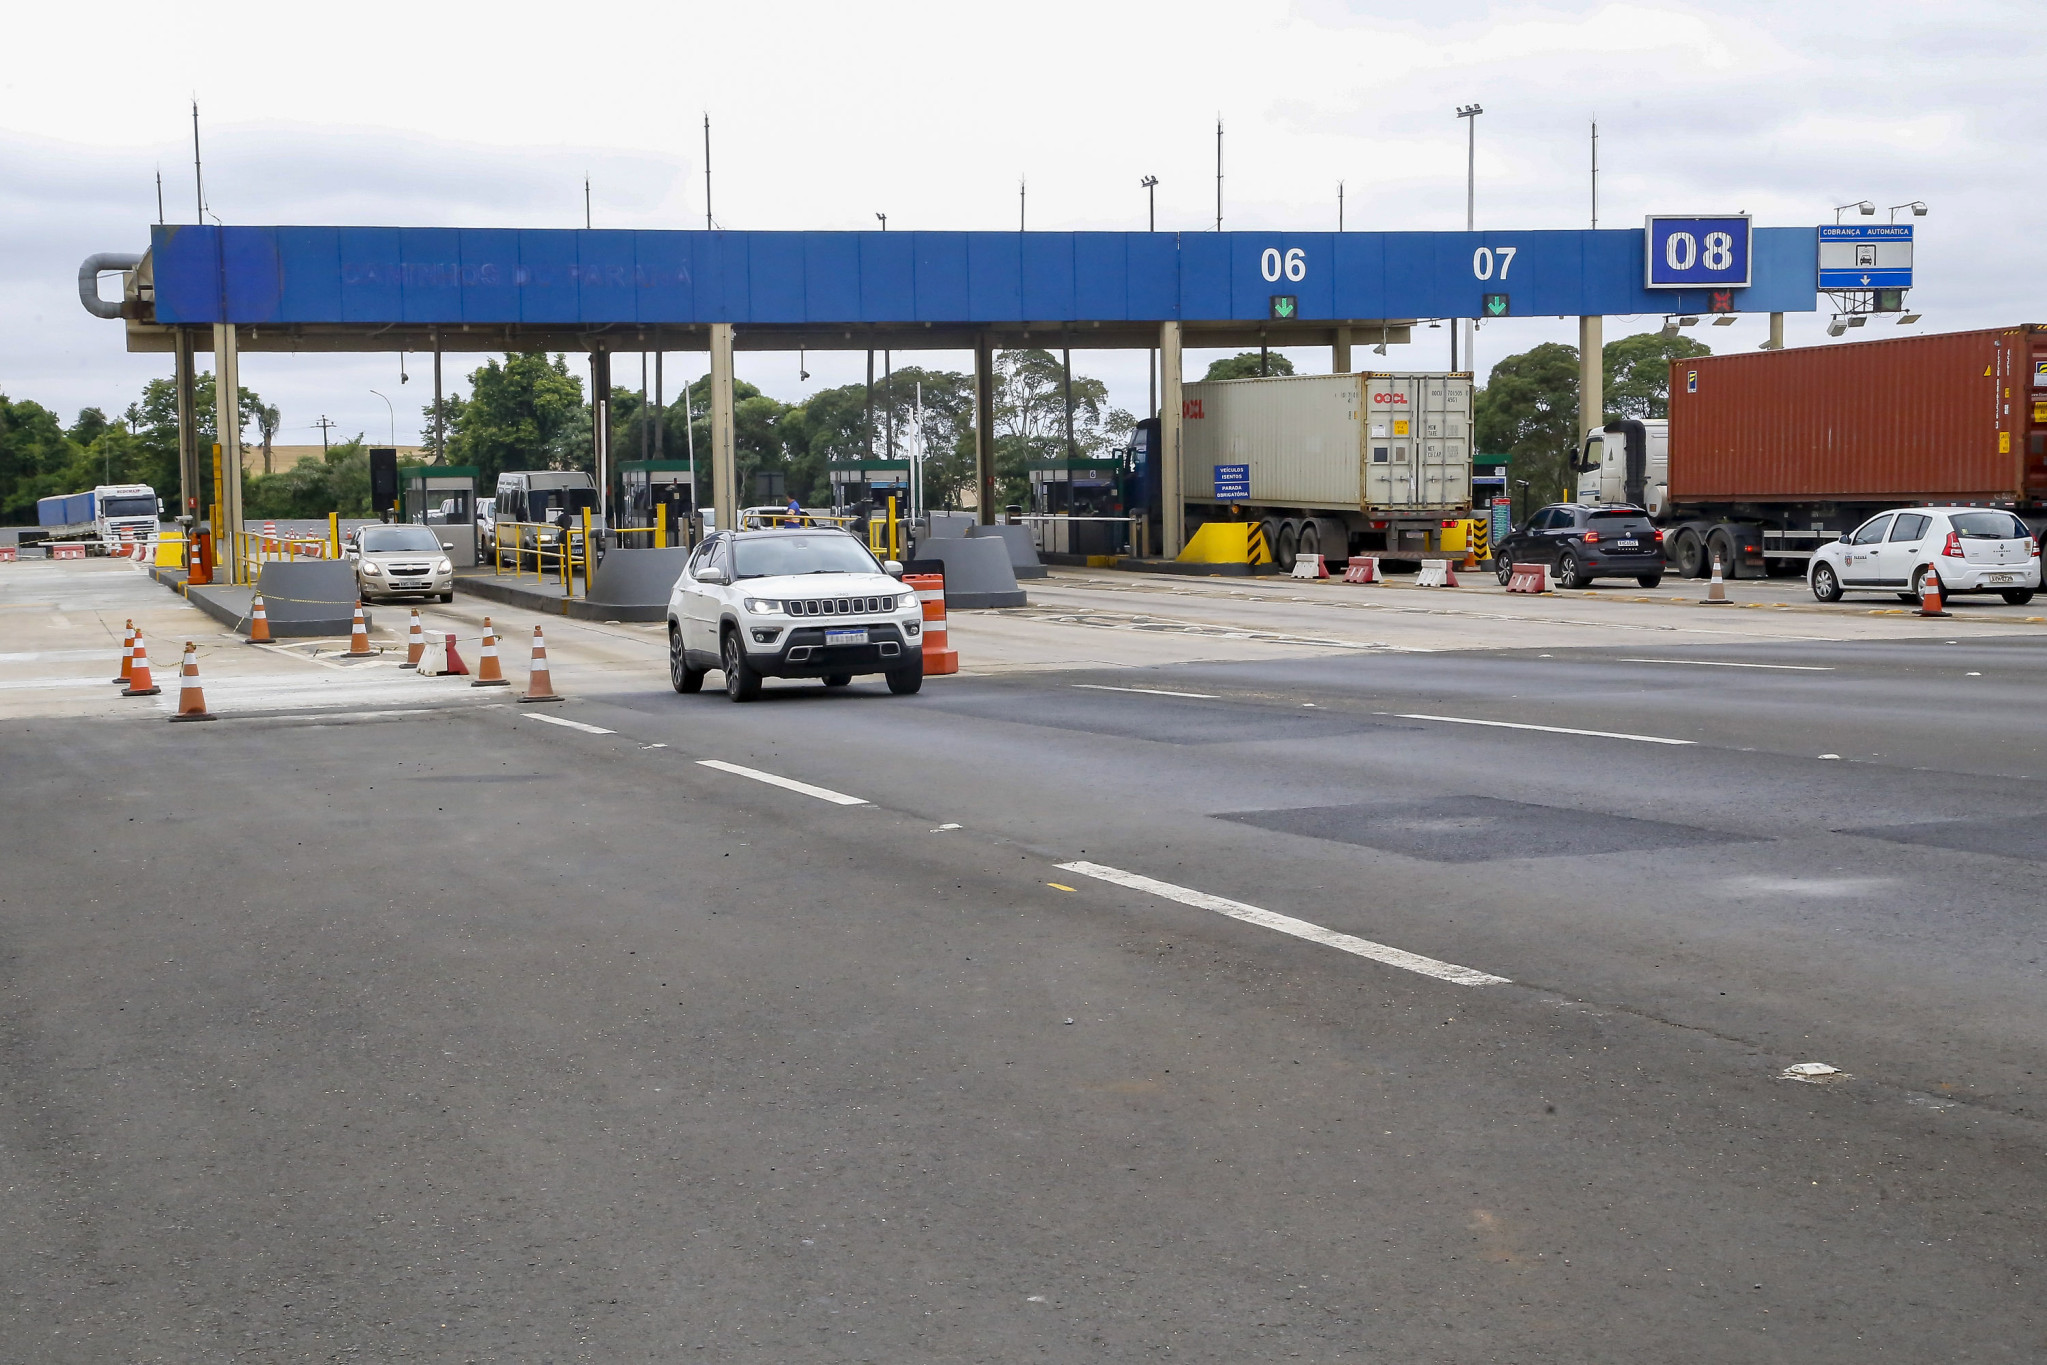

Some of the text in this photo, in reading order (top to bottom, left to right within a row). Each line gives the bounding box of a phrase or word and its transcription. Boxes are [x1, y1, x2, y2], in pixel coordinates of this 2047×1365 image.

[1822, 226, 1909, 237] COBRANÇA AUTOMÁTICA
[1665, 231, 1733, 271] 08
[1261, 247, 1307, 282] 06
[1472, 246, 1517, 281] 07
[1374, 393, 1408, 404] OOCL
[1216, 490, 1249, 498] OBRIGATÓRIA
